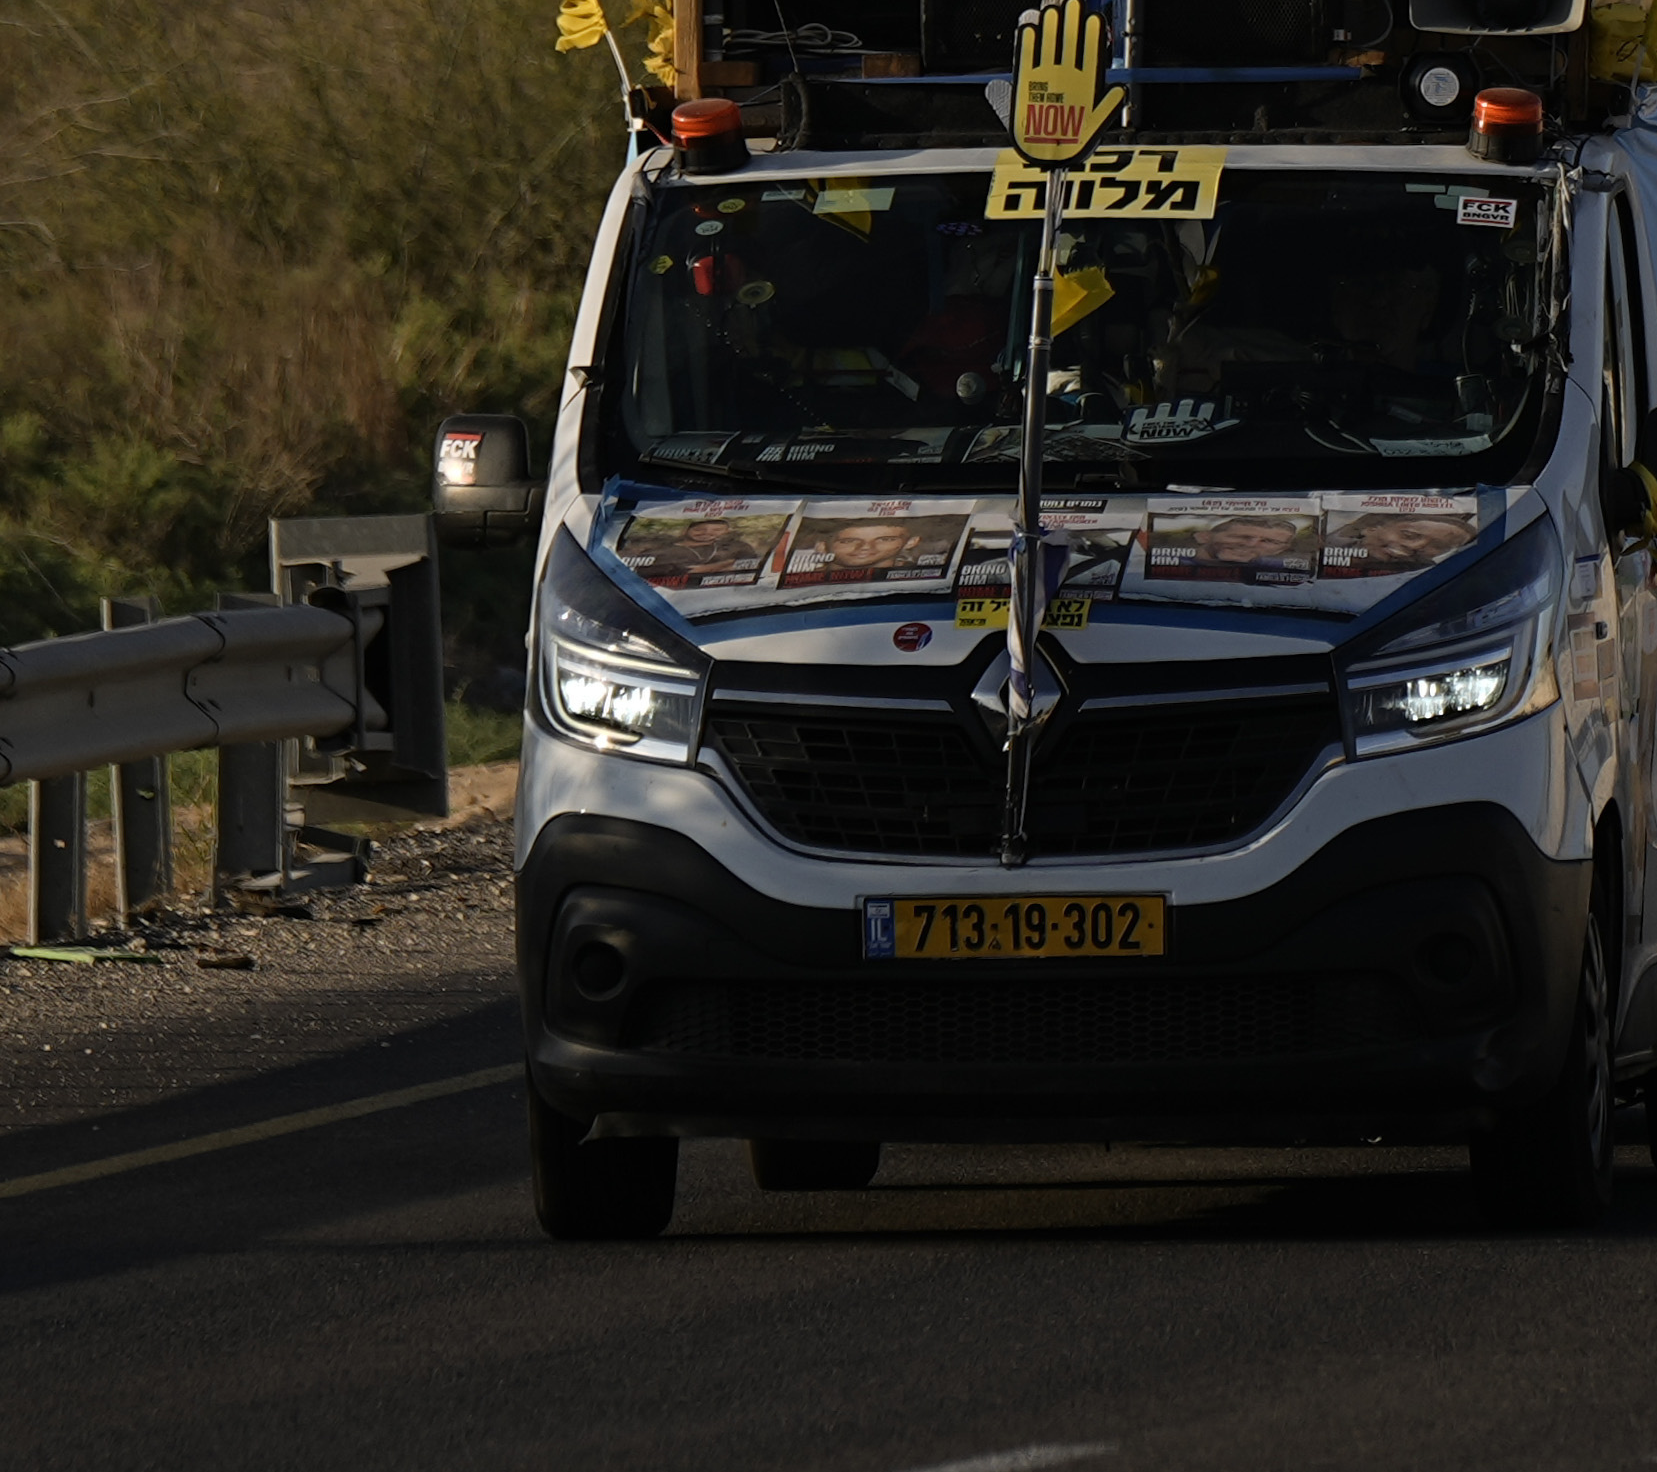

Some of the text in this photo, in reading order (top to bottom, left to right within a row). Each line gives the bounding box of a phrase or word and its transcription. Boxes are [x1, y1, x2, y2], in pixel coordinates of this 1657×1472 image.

[1029, 81, 1048, 91] BRING
[1029, 92, 1064, 103] THEM HOME
[1025, 104, 1085, 137] NOW
[1462, 201, 1511, 214] FCK
[1462, 211, 1510, 222] BNGVR
[439, 439, 479, 459] FCK
[1151, 547, 1196, 557] BRING
[1323, 547, 1368, 558] BRING
[1150, 556, 1179, 566] HIM
[1322, 556, 1351, 567] HIM
[961, 564, 1006, 575] BRING
[958, 574, 988, 585] HIM
[961, 601, 984, 612] זה
[1057, 600, 1085, 613] לא
